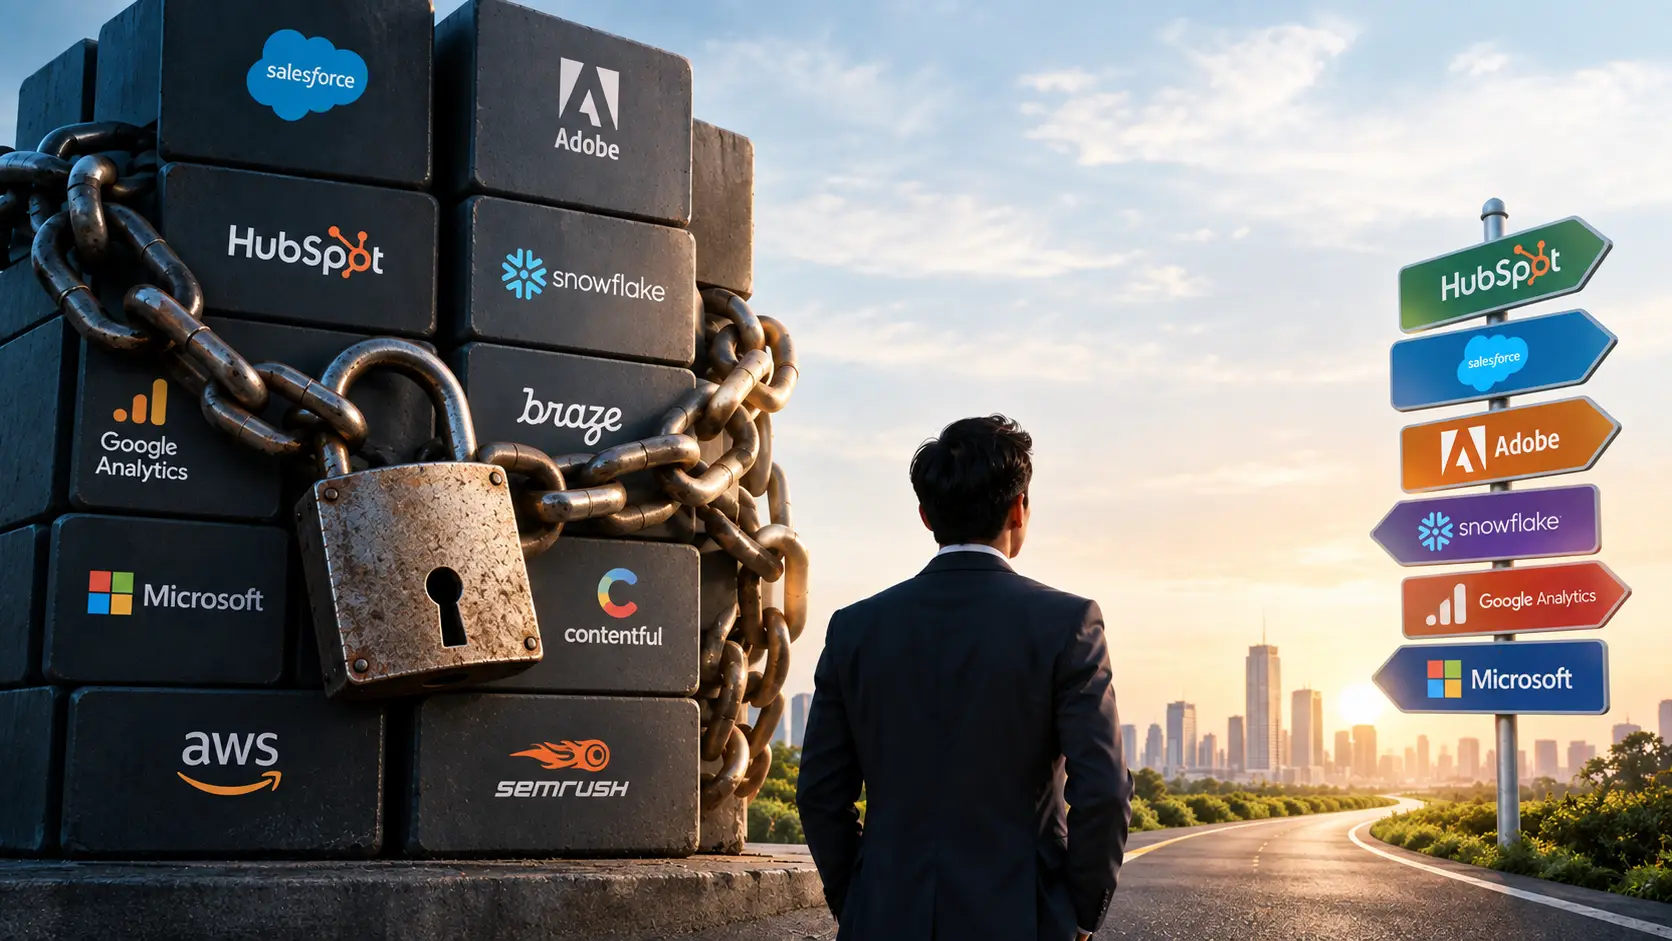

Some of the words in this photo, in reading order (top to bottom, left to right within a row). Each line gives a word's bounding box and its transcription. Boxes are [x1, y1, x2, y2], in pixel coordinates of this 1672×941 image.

[265, 62, 355, 90] salesforce
[554, 127, 620, 161] Adobe
[228, 224, 384, 279] HubSpot
[1441, 240, 1561, 301] HubSpot
[552, 268, 666, 303] snowflake
[1468, 351, 1520, 369] salesforce
[517, 387, 622, 446] braze
[100, 431, 178, 459] Google
[1495, 428, 1560, 457] Adobe
[95, 456, 188, 482] Analytics
[1459, 511, 1559, 536] snowflake
[143, 583, 264, 612] Microsoft
[1479, 591, 1533, 611] Google
[1537, 589, 1597, 608] Analytics
[564, 625, 663, 647] contentful
[1471, 667, 1573, 690] Microsoft
[181, 730, 279, 767] aws
